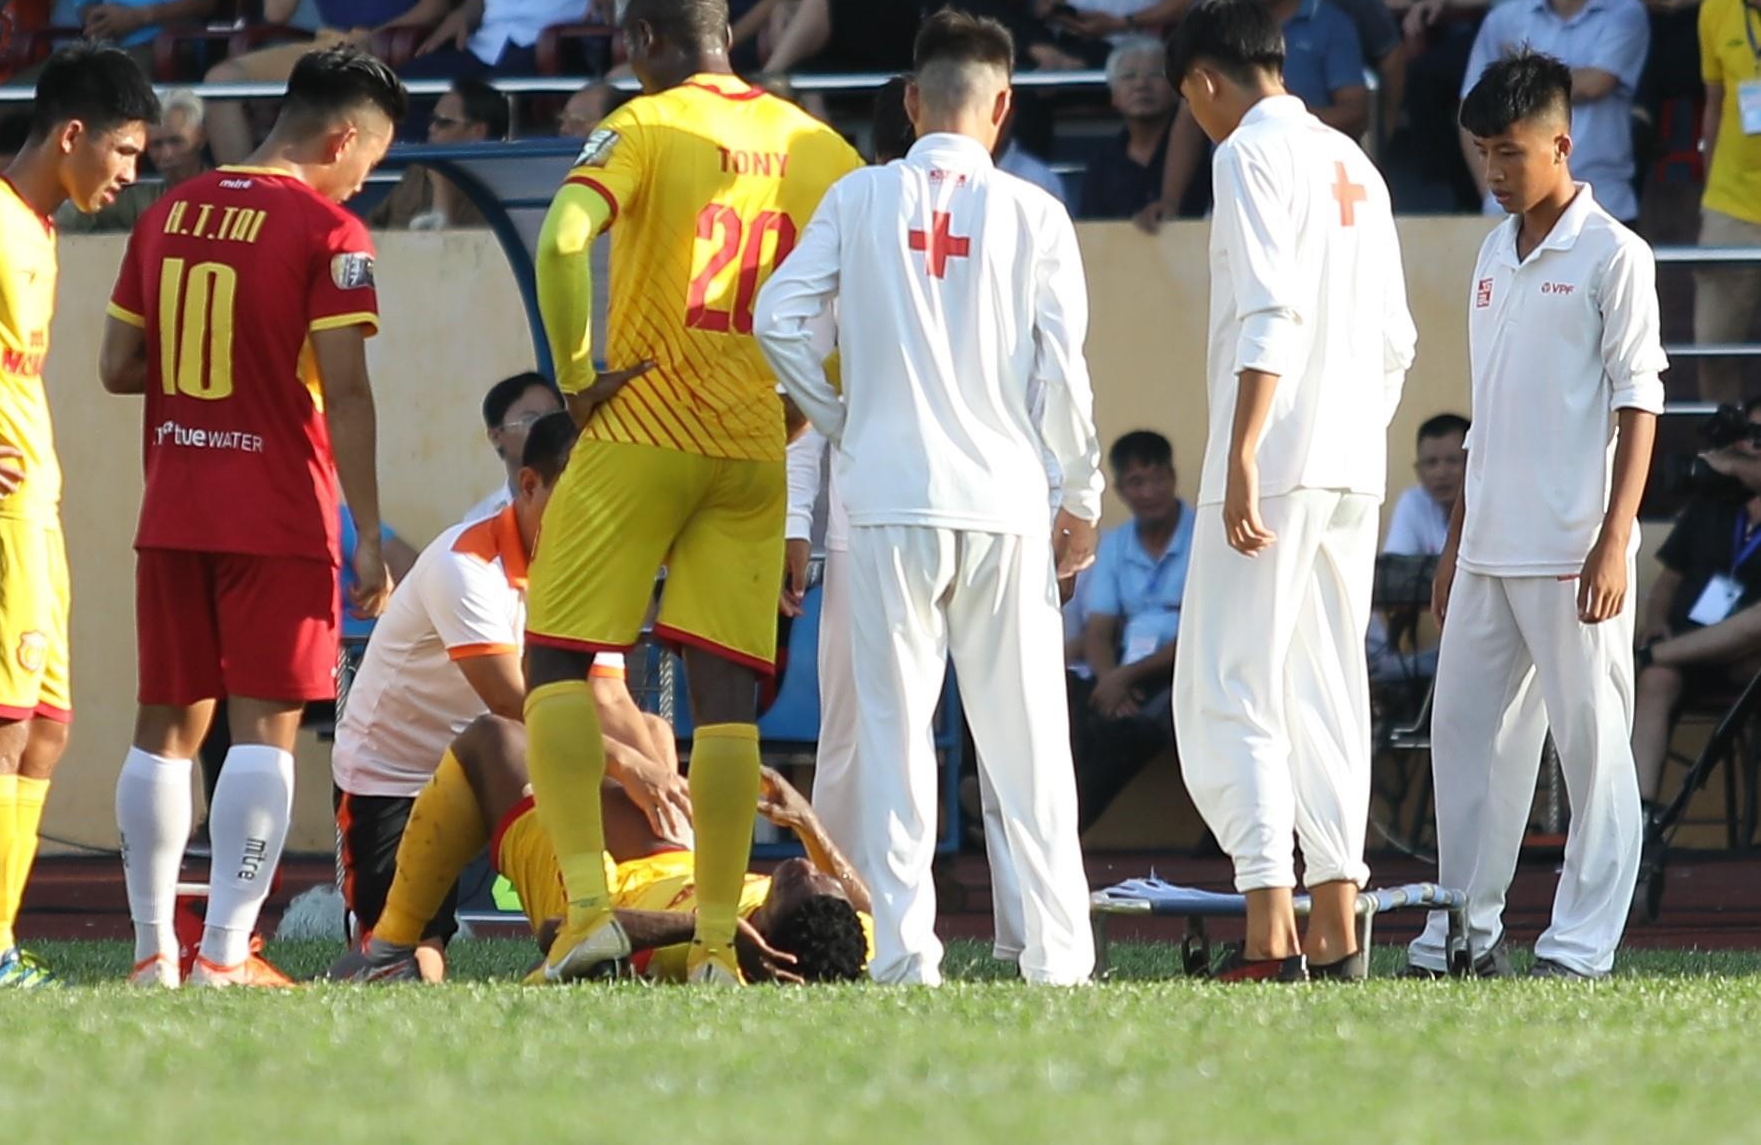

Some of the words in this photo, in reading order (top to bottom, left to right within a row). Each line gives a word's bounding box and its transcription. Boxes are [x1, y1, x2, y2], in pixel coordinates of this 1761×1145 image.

[717, 144, 790, 178] TONY
[685, 202, 797, 335] 20
[1552, 283, 1575, 295] VPF
[158, 257, 237, 400] 10
[237, 837, 267, 881] mitre
